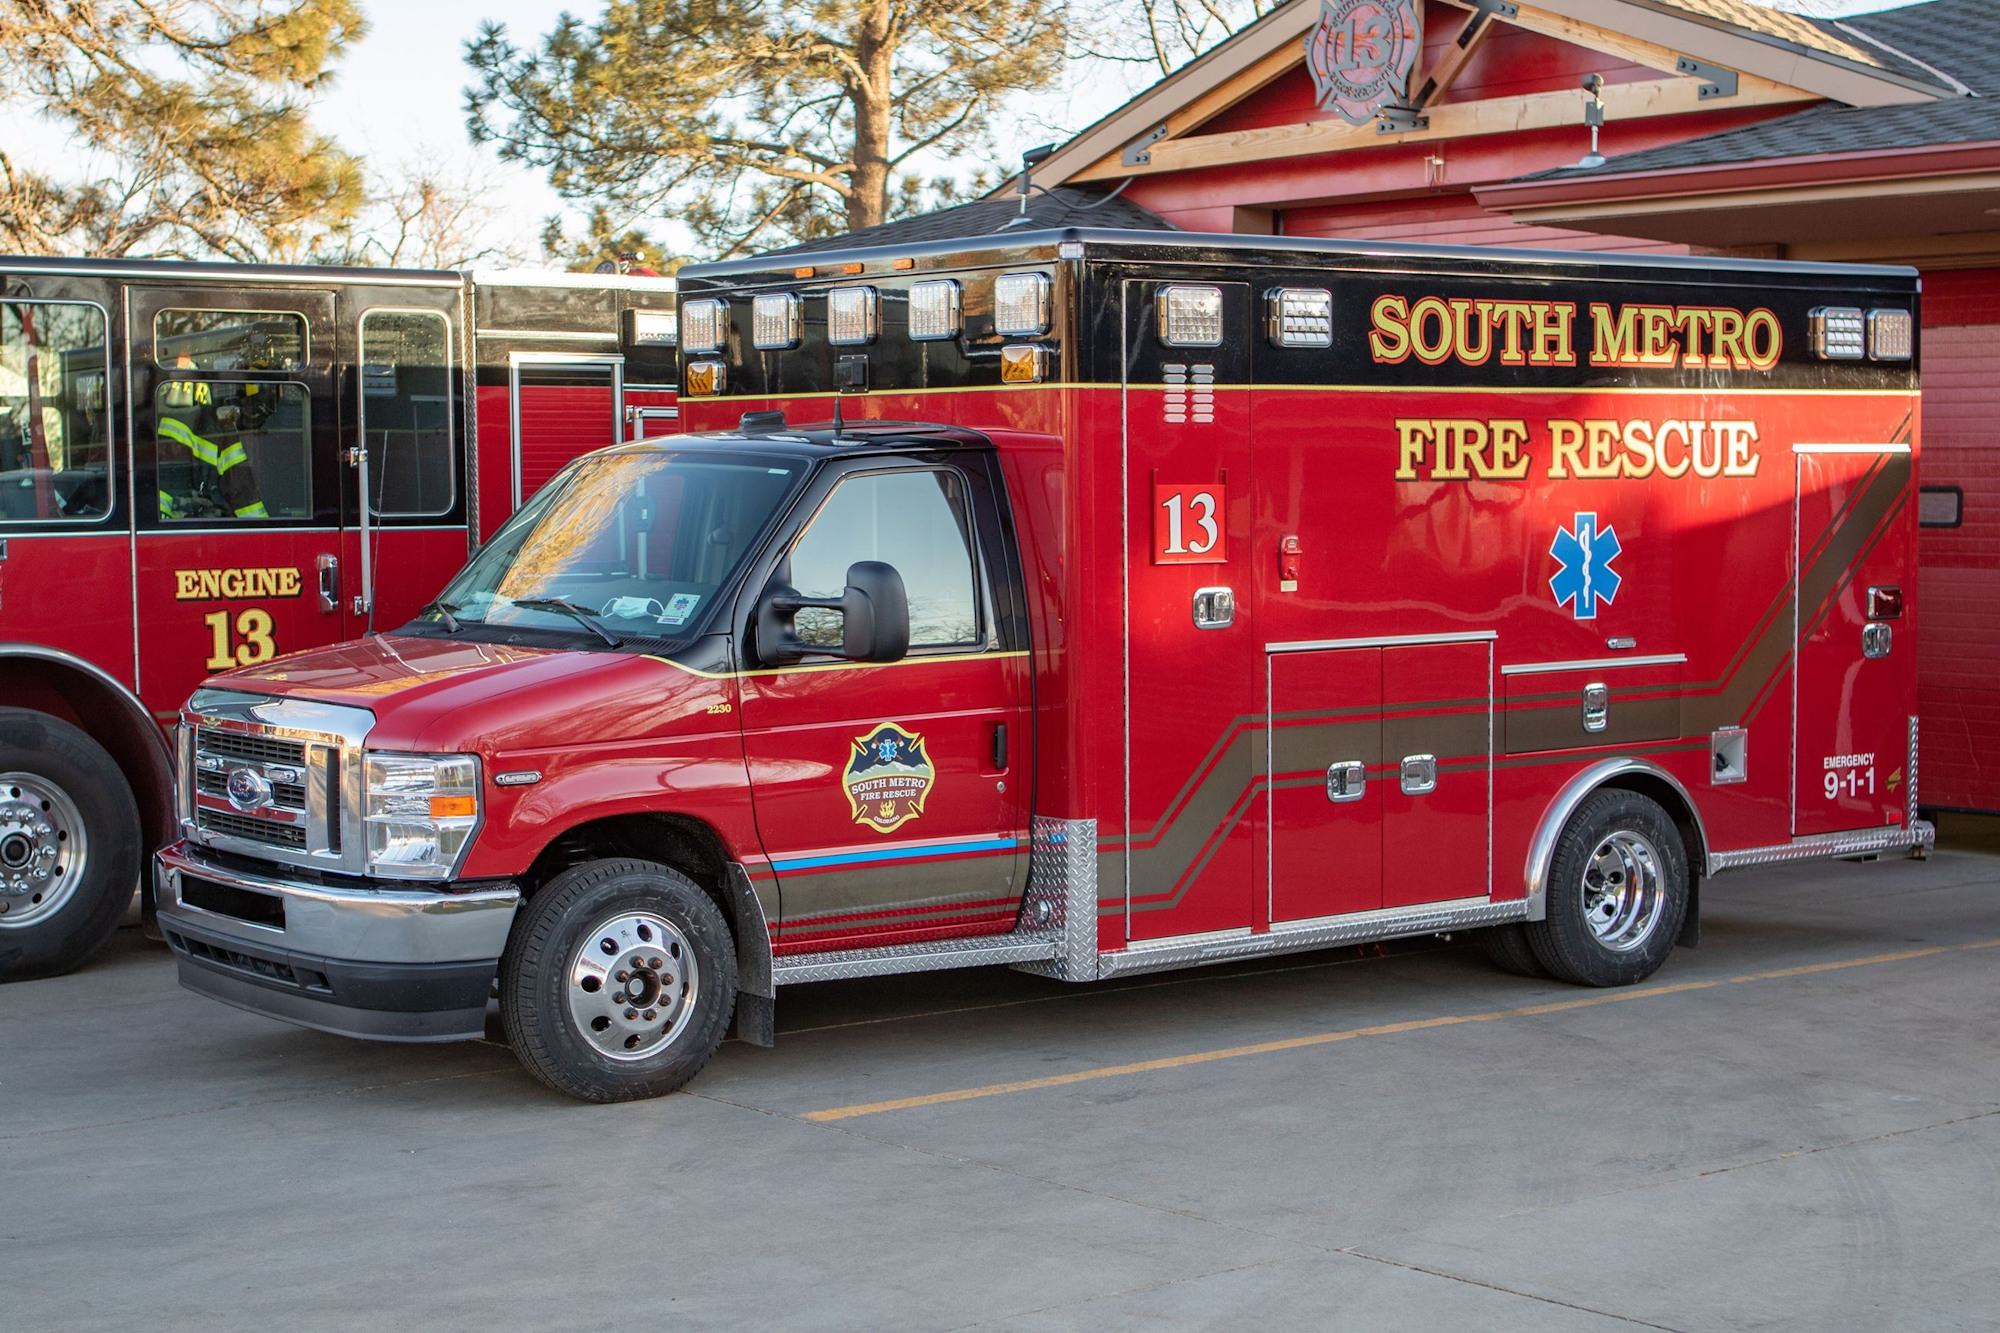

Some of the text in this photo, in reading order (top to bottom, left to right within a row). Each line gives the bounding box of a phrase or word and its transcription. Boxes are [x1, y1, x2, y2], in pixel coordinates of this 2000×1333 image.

[1333, 15, 1393, 71] 13
[1368, 294, 1783, 371] SOUTH METRO
[1394, 418, 1761, 482] FIRE RESCUE
[1162, 492, 1219, 554] 13
[175, 567, 304, 601] ENGINE
[204, 608, 277, 671] 13
[707, 704, 732, 715] 2230
[1823, 752, 1875, 769] EMERGENCY
[851, 777, 926, 795] SOUTH METRO
[860, 789, 917, 801] FIRE RESCUE
[1823, 766, 1875, 800] 9-1-1
[873, 814, 900, 824] COLORADO
